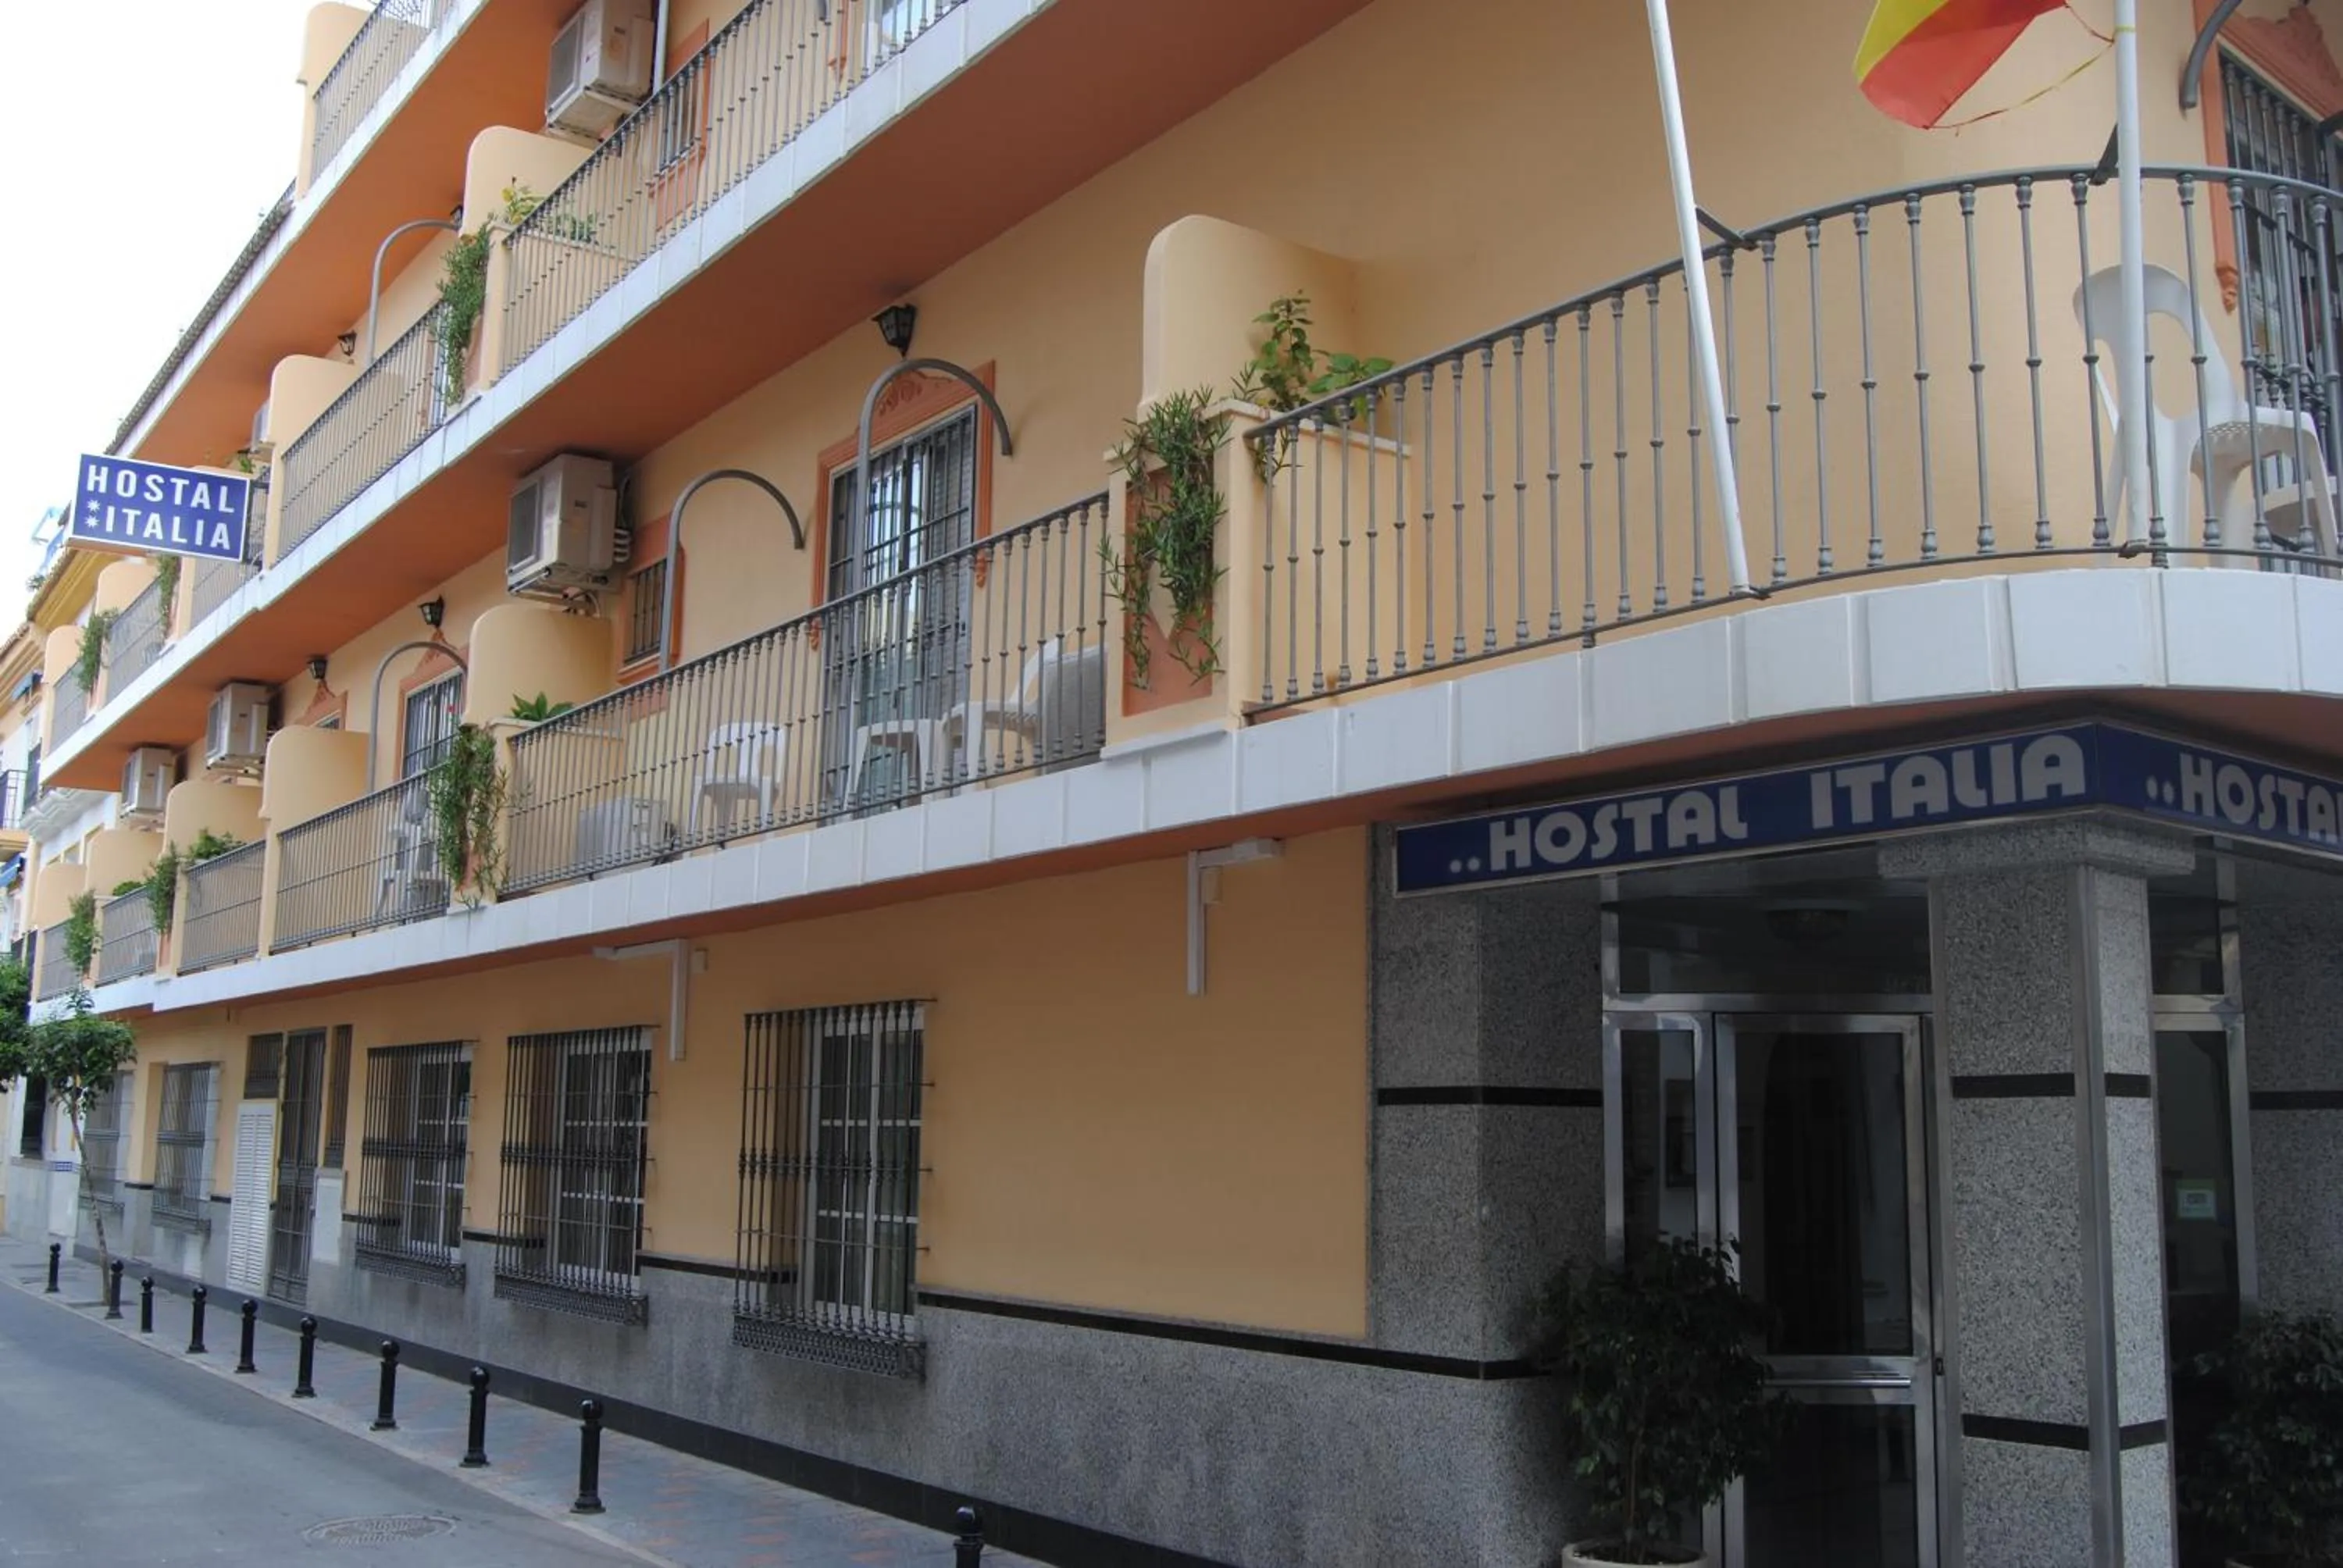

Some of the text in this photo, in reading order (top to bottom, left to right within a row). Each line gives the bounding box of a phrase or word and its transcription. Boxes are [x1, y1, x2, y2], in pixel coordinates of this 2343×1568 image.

[87, 464, 235, 513] HOSTAL
[105, 505, 230, 550] ITALIA
[1489, 735, 2086, 871] HOSTAL ITALIA
